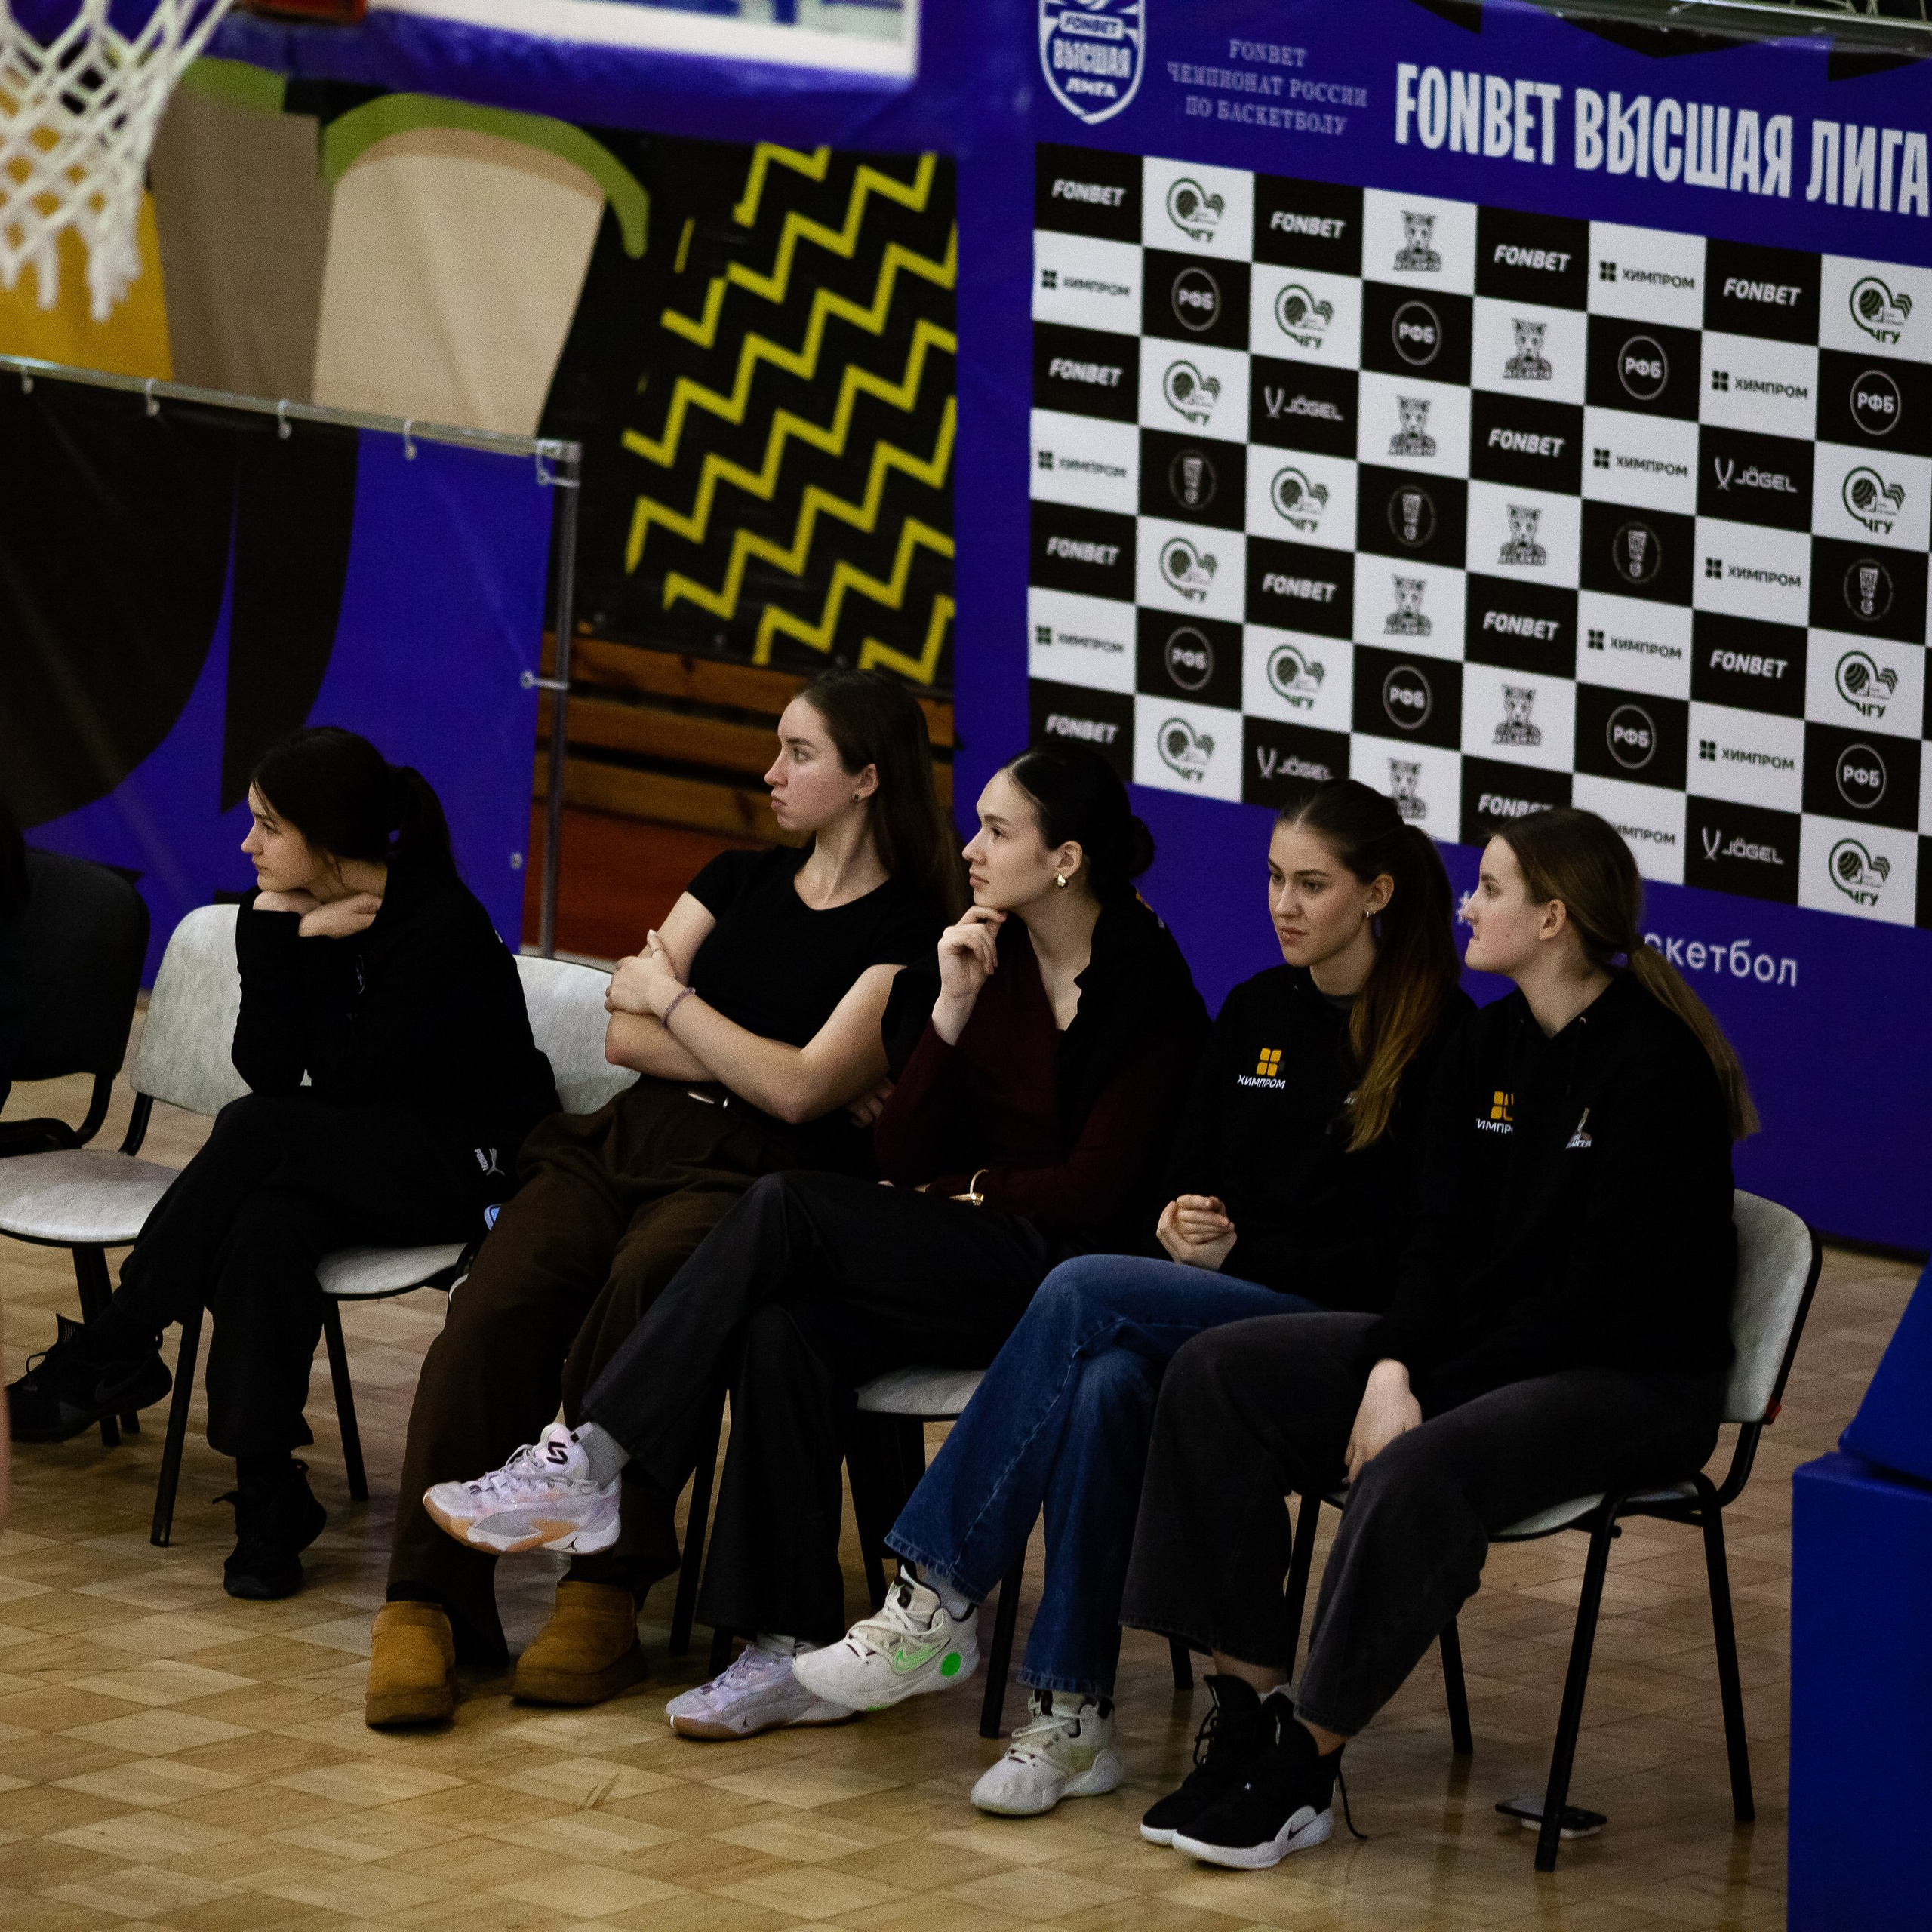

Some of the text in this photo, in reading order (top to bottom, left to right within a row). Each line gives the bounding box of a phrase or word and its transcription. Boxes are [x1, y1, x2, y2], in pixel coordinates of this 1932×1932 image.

[1053, 38, 1131, 78] ВЫСШАЯ
[1229, 38, 1307, 68] FONBET
[1167, 61, 1368, 108] ЧЕМПИОНАТ РОССИИ
[1186, 95, 1348, 136] ПО БАСКЕТБОЛУ
[1395, 63, 1930, 217] FONBET ВЫСШАЯ ЛИГА
[1051, 179, 1126, 206] FONBET
[1270, 211, 1346, 238] FONBET
[1494, 245, 1571, 272] FONBET
[1623, 269, 1696, 290] ХИМПРОМ
[1723, 278, 1801, 306] FONBET
[1624, 357, 1662, 379] РФБ
[1735, 378, 1809, 399] ХИМПРОМ
[1857, 392, 1894, 413] РФБ
[1487, 428, 1565, 457] FONBET
[1616, 456, 1689, 478] ХИМПРОМ
[1262, 573, 1337, 602] FONBET
[1728, 566, 1801, 588] ХИМПРОМ
[1483, 611, 1560, 641] FONBET
[1610, 637, 1683, 660] ХИМПРОМ
[1709, 649, 1788, 679] FONBET
[1613, 725, 1651, 748] РФБ
[1721, 749, 1795, 771] ХИМПРОМ
[1842, 764, 1880, 788] РФБ
[1613, 824, 1675, 845] ИМПРОМ
[1237, 1074, 1286, 1090] ХИМПРОМ
[1476, 1118, 1513, 1134] ИМПР
